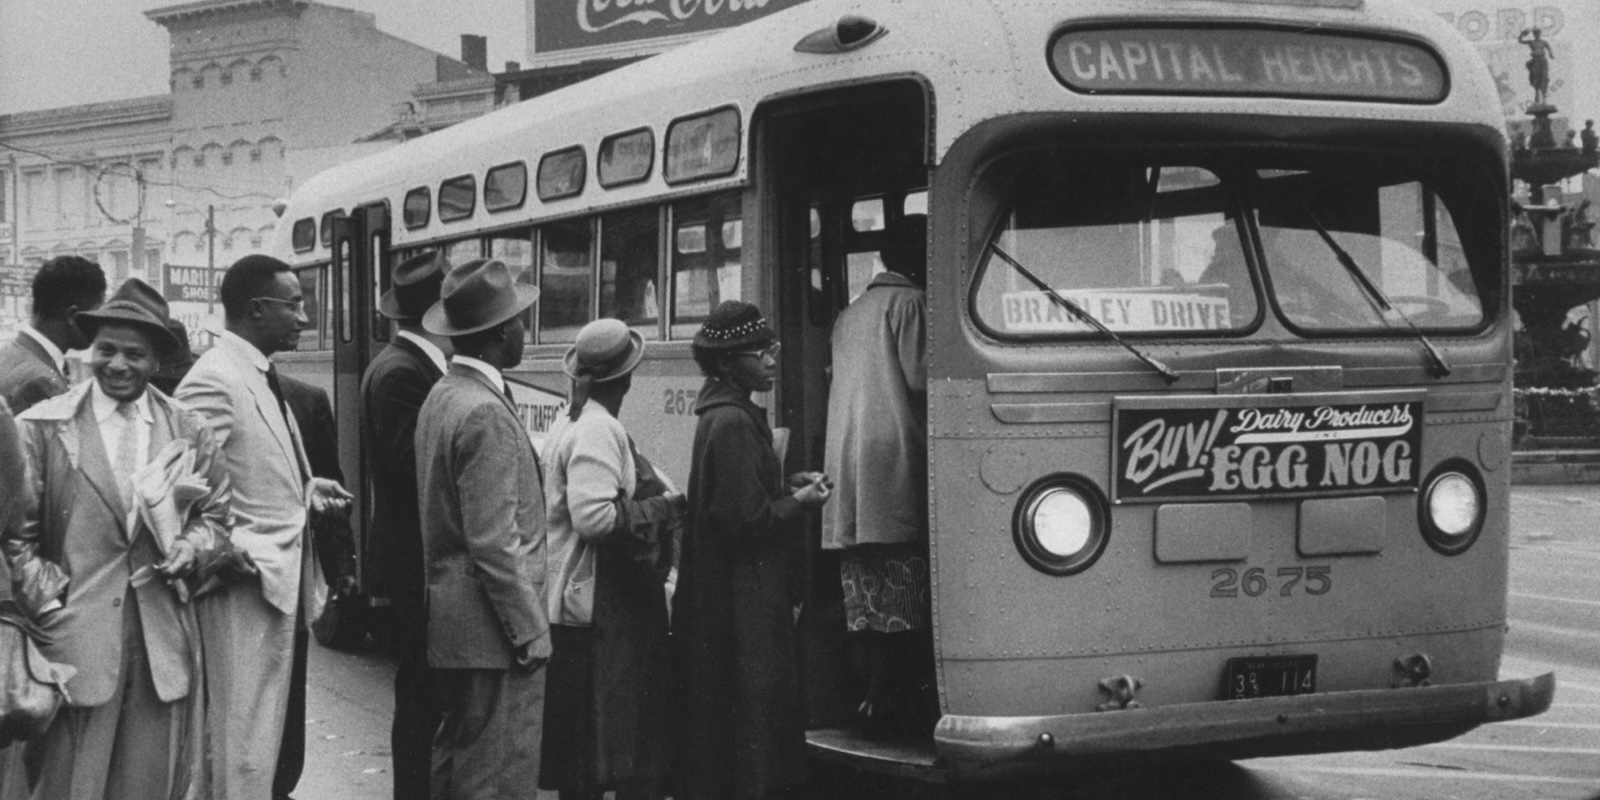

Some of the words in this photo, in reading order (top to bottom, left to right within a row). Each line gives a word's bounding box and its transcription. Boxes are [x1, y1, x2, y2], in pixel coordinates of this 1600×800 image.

[1436, 6, 1565, 41] ORD
[1069, 40, 1242, 81] CAPITAL
[1261, 47, 1423, 86] HEIGHTS
[182, 286, 217, 300] SHOES
[1005, 297, 1131, 326] BRALEY
[1150, 299, 1230, 329] DRIVE
[1230, 408, 1303, 432] Dairy
[1305, 403, 1413, 428] Producers
[1209, 445, 1308, 490] EGG
[1320, 440, 1412, 486] NOG
[1210, 565, 1332, 598] 2675
[1236, 674, 1245, 693] 3
[1282, 670, 1312, 691] 114
